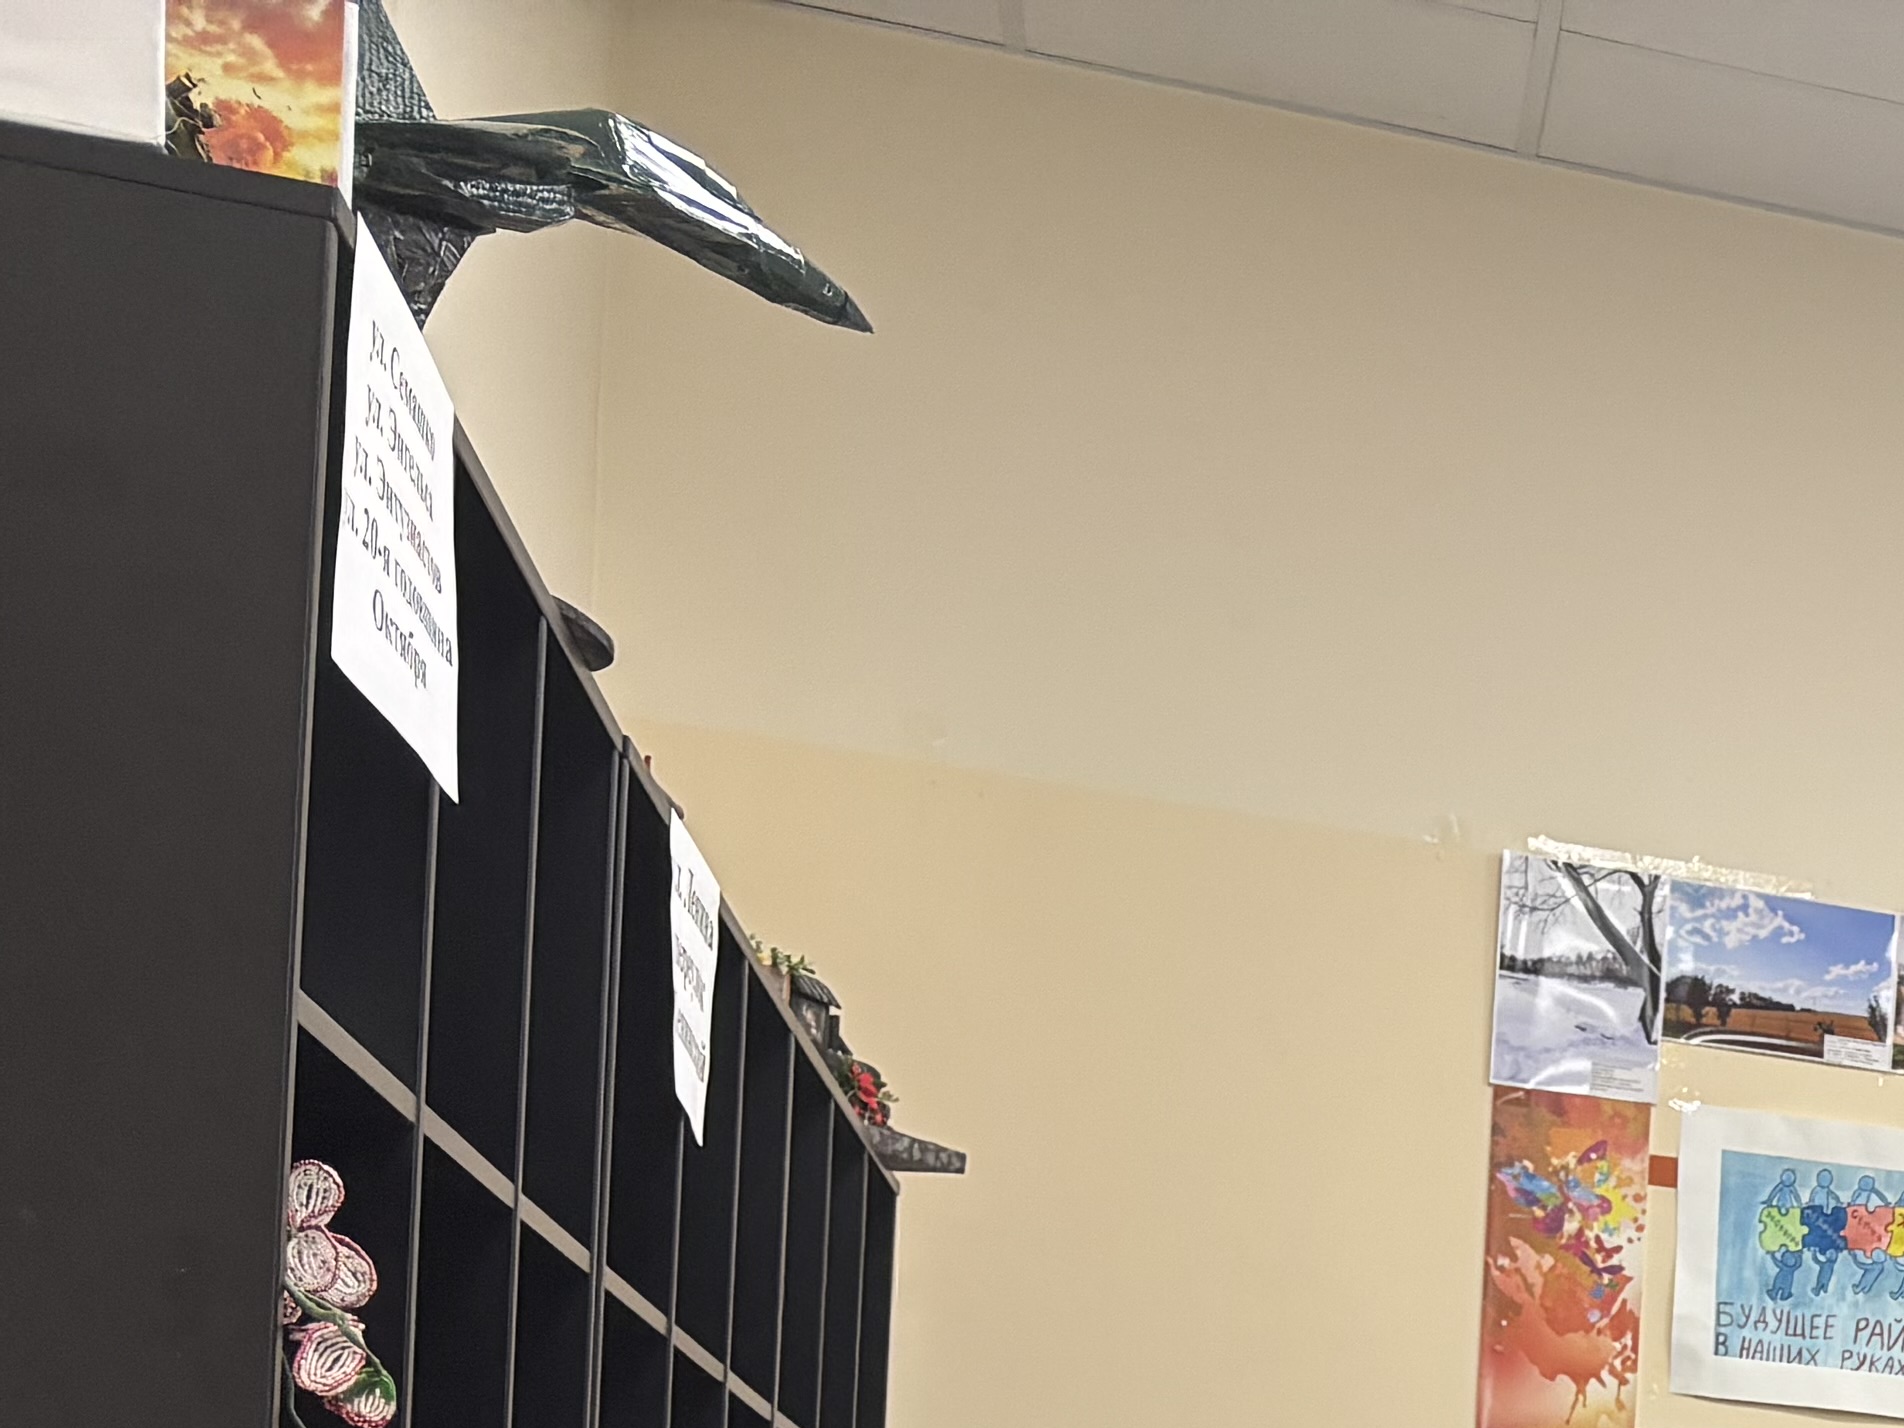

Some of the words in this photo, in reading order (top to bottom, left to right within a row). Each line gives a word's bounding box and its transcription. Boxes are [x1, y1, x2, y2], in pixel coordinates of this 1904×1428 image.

[369, 319, 387, 372] ул.
[365, 384, 383, 437] ул.
[353, 435, 372, 487] ул.
[372, 589, 428, 690] Октября
[1715, 1301, 1838, 1341] БУДУЩЕЕ
[1713, 1332, 1729, 1358] В
[1738, 1336, 1821, 1367] НАШИХ
